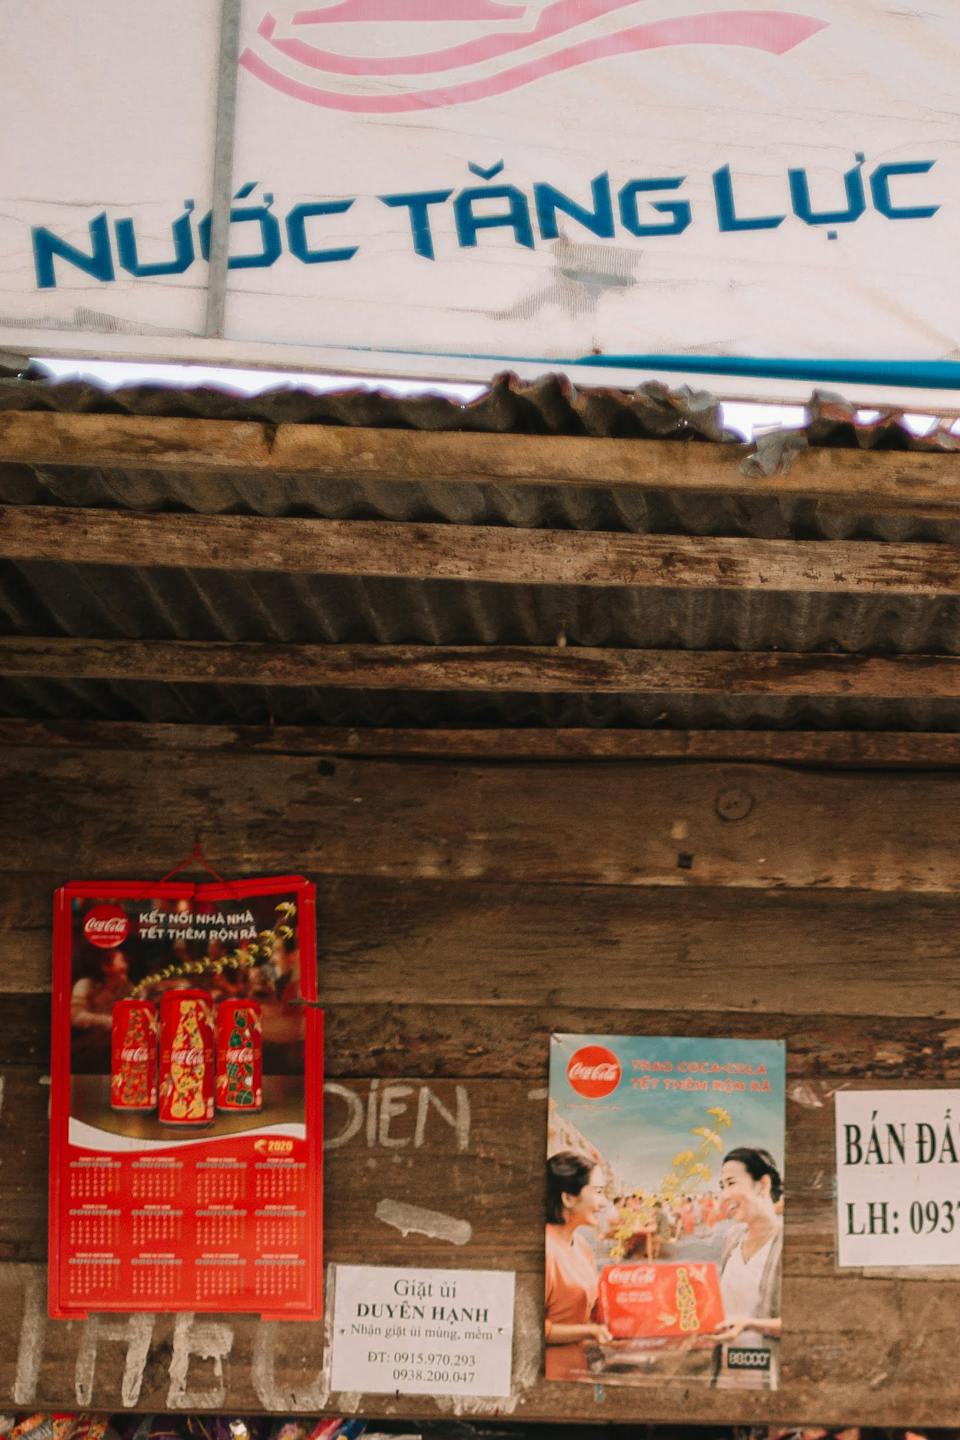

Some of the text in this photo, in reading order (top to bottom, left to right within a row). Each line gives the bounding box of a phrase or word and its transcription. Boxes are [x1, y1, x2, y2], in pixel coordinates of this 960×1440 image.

[31, 152, 942, 289] NƯỚC TĂNG LỰC
[139, 909, 166, 924] KẾT
[268, 1140, 293, 1152] 2020
[843, 1110, 906, 1166] BÁN
[846, 1202, 900, 1236] LH:
[394, 1279, 433, 1300] Giặt
[357, 1301, 489, 1325] DUYÊN HẠNH
[367, 1352, 476, 1367] ĐT: 0915.970.293
